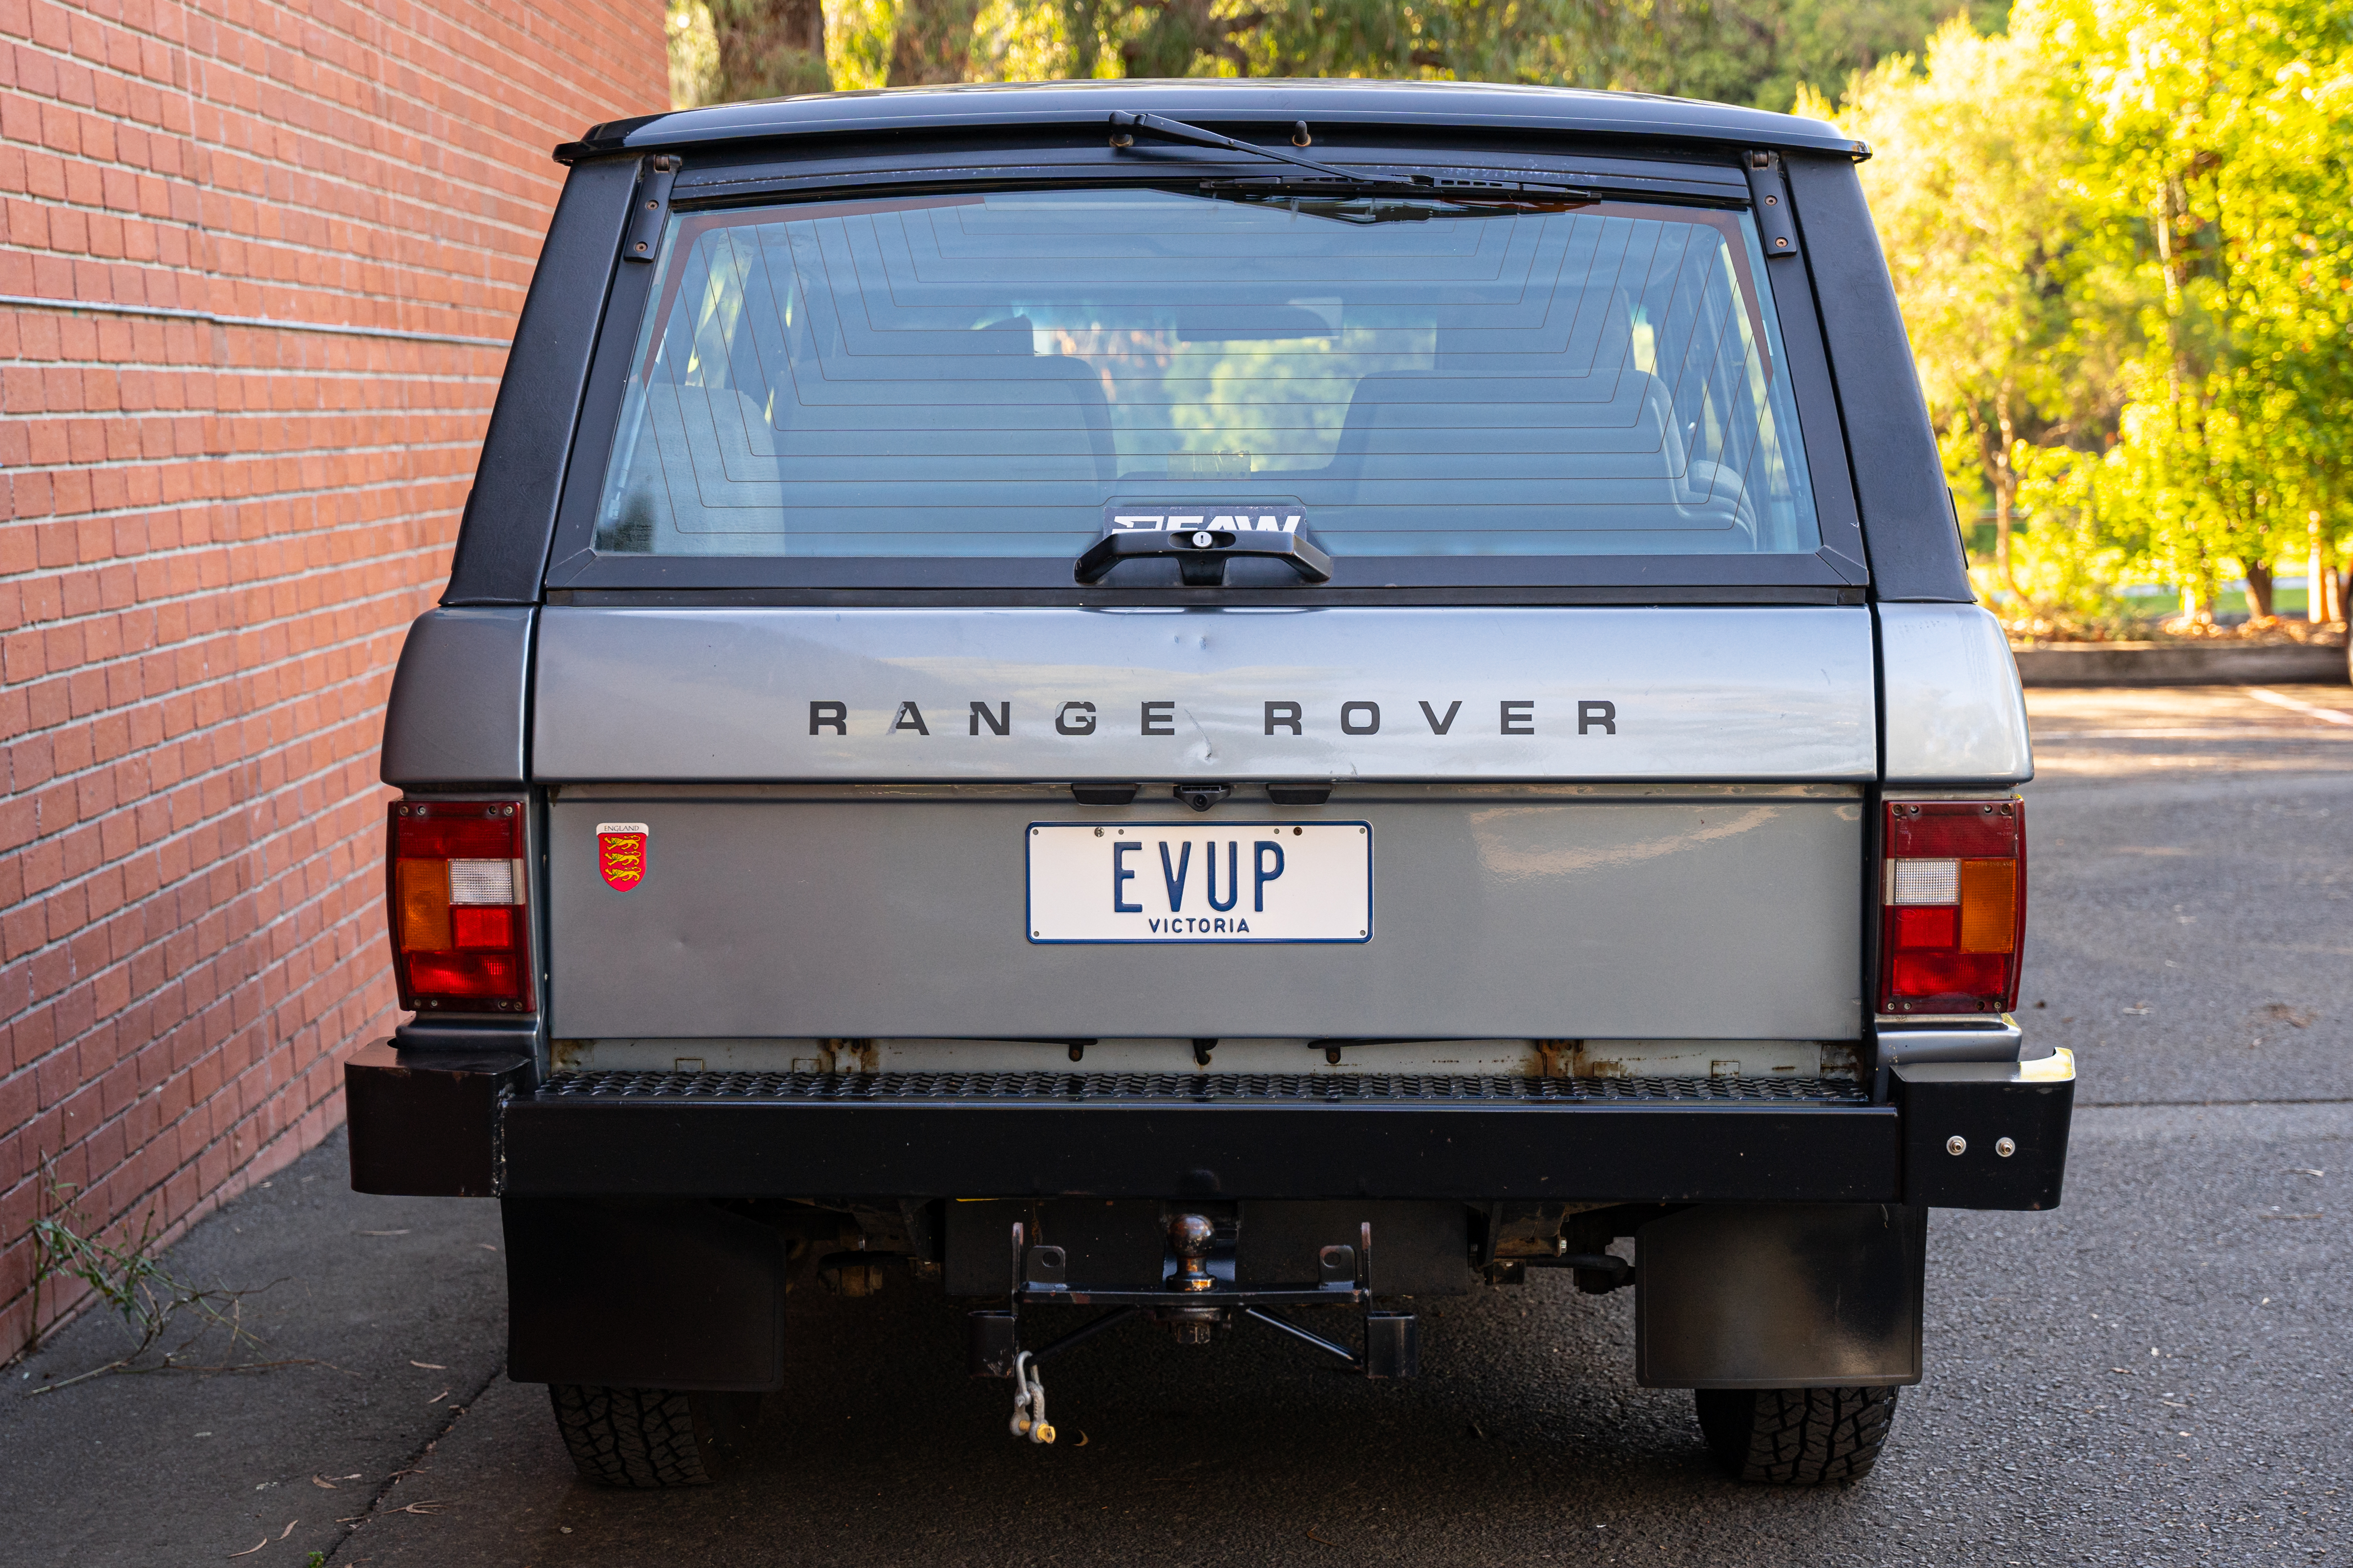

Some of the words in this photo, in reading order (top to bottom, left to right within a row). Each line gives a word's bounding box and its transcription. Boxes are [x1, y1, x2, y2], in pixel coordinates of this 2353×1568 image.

[809, 701, 1175, 736] RANGE
[1264, 700, 1616, 735] ROVER
[1114, 841, 1285, 913] EVUP
[1149, 918, 1249, 933] VICTORIA
